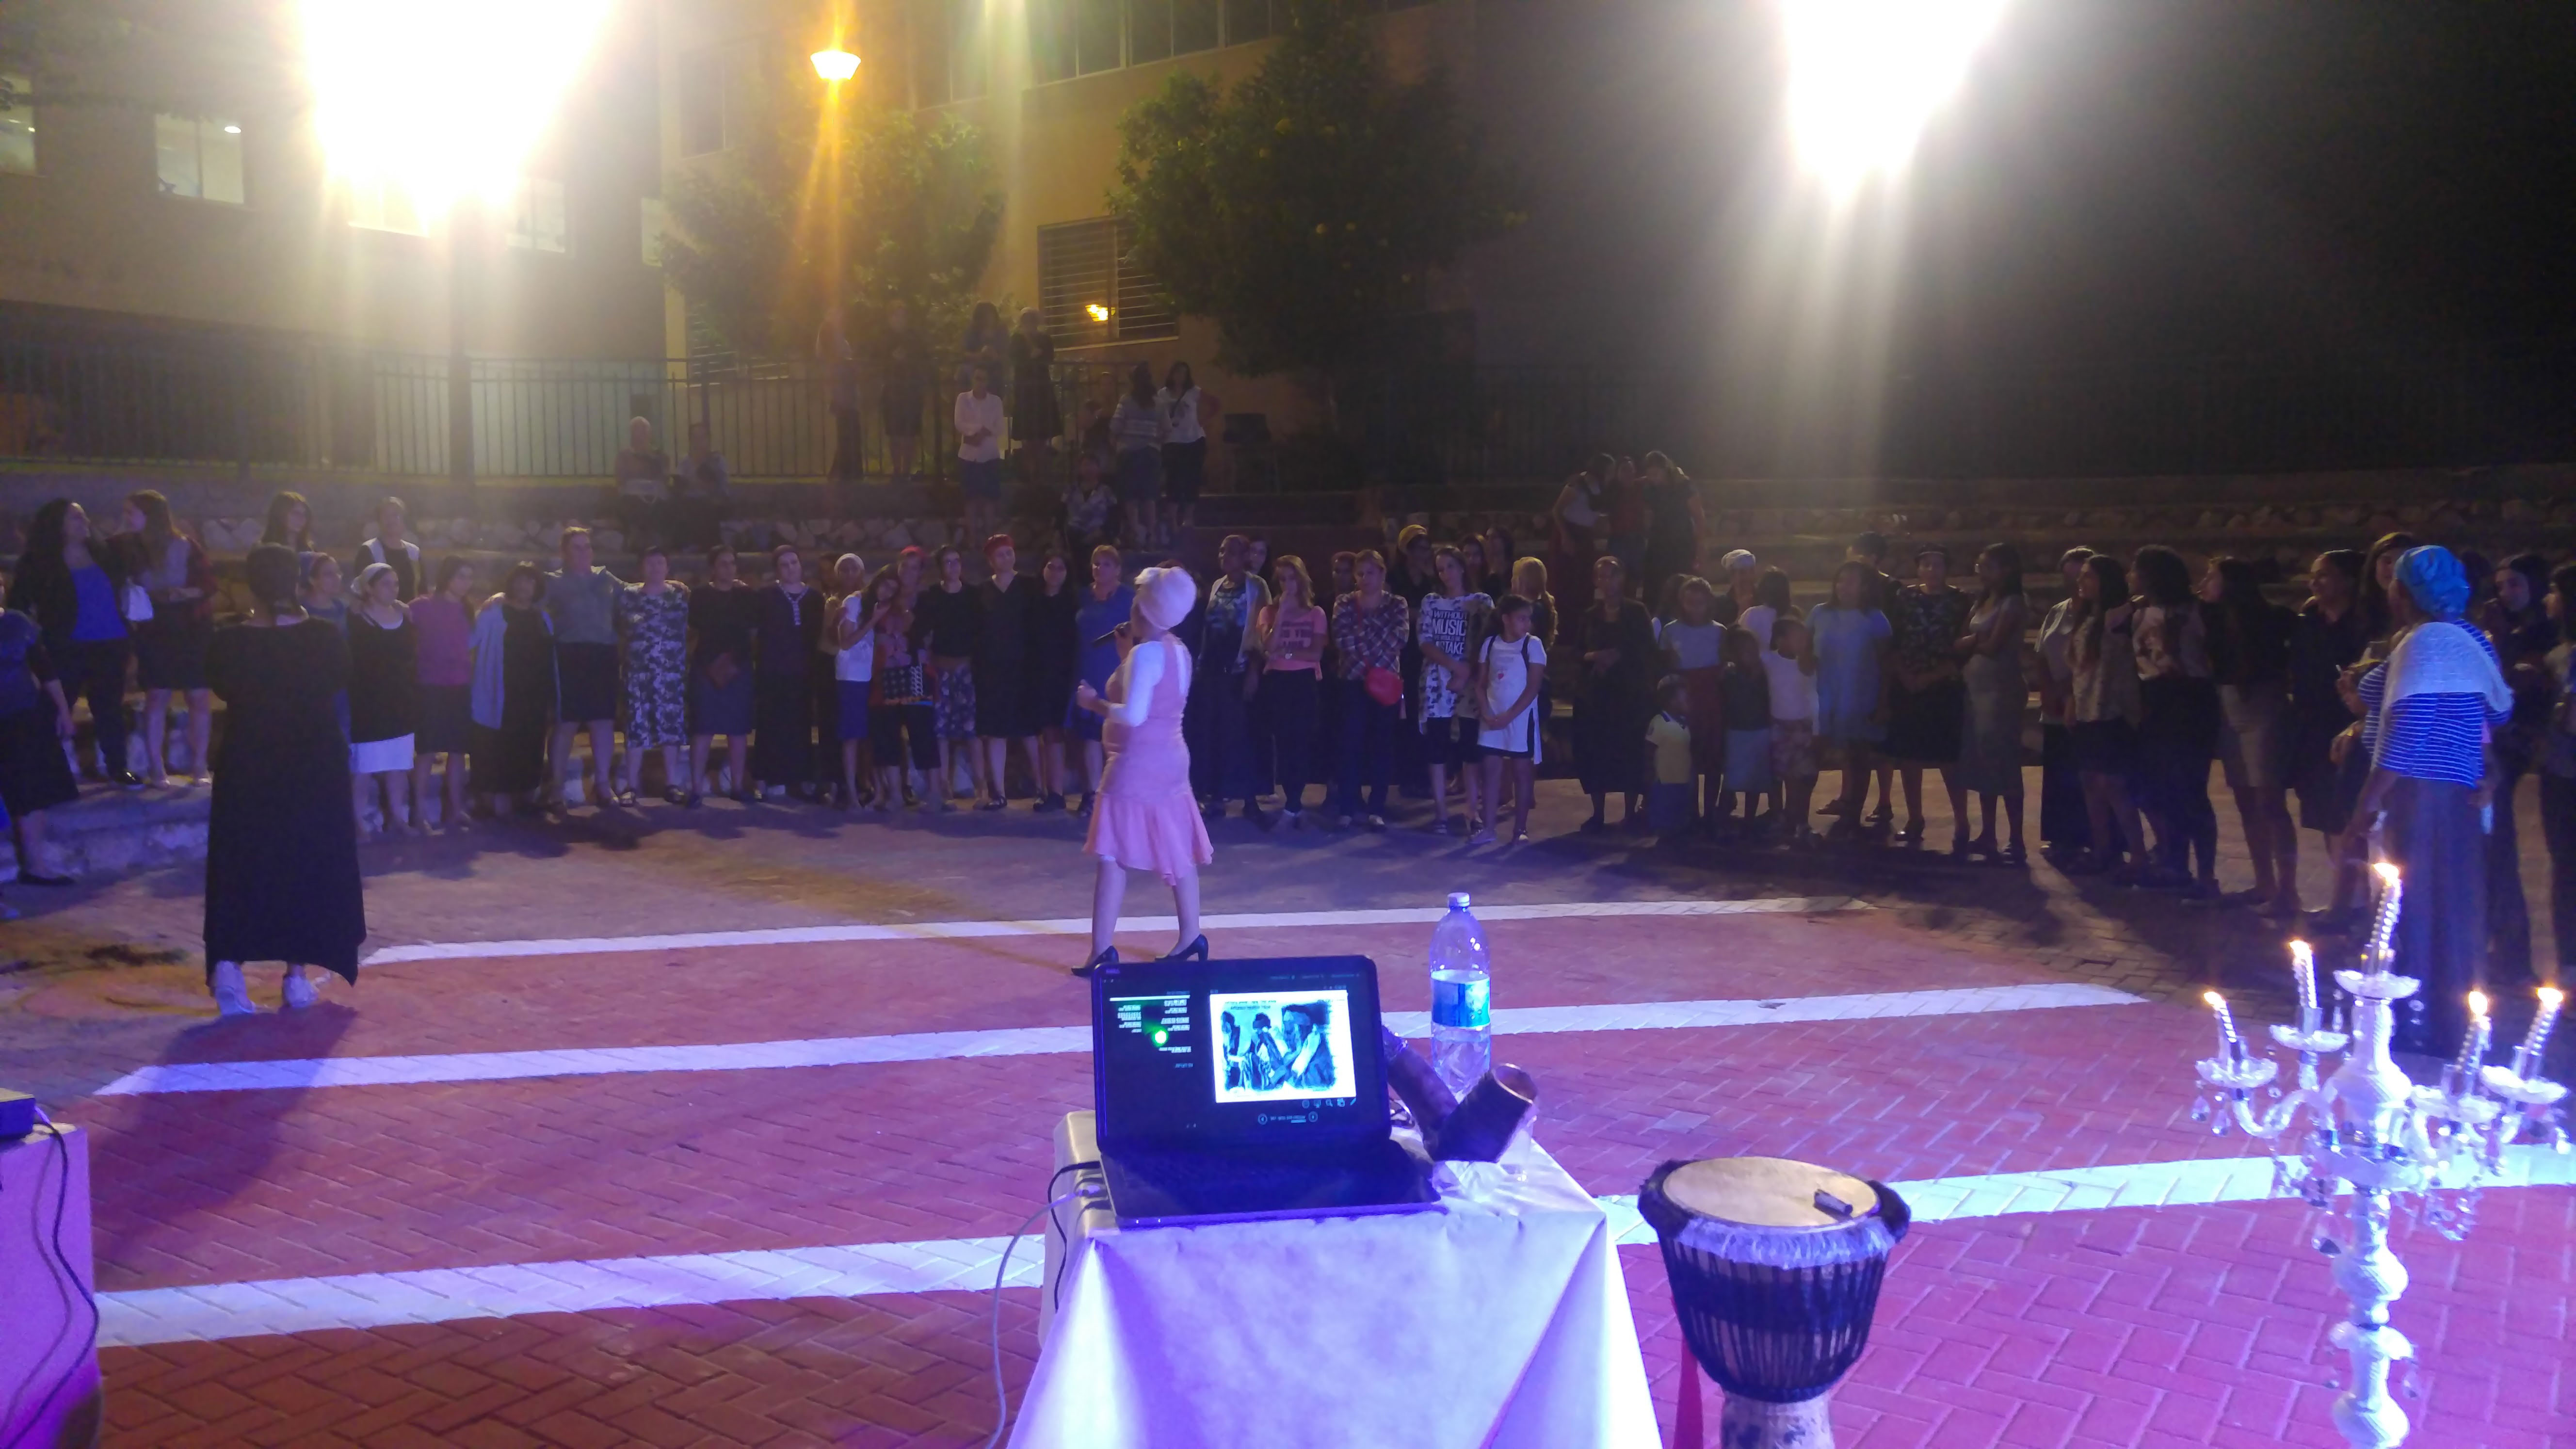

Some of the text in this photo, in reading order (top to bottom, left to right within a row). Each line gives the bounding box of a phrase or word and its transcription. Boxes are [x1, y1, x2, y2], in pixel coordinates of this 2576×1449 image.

[1434, 610, 1467, 619] WITHOUT
[1432, 618, 1467, 636] MUSIC
[1435, 641, 1465, 655] STAKE
